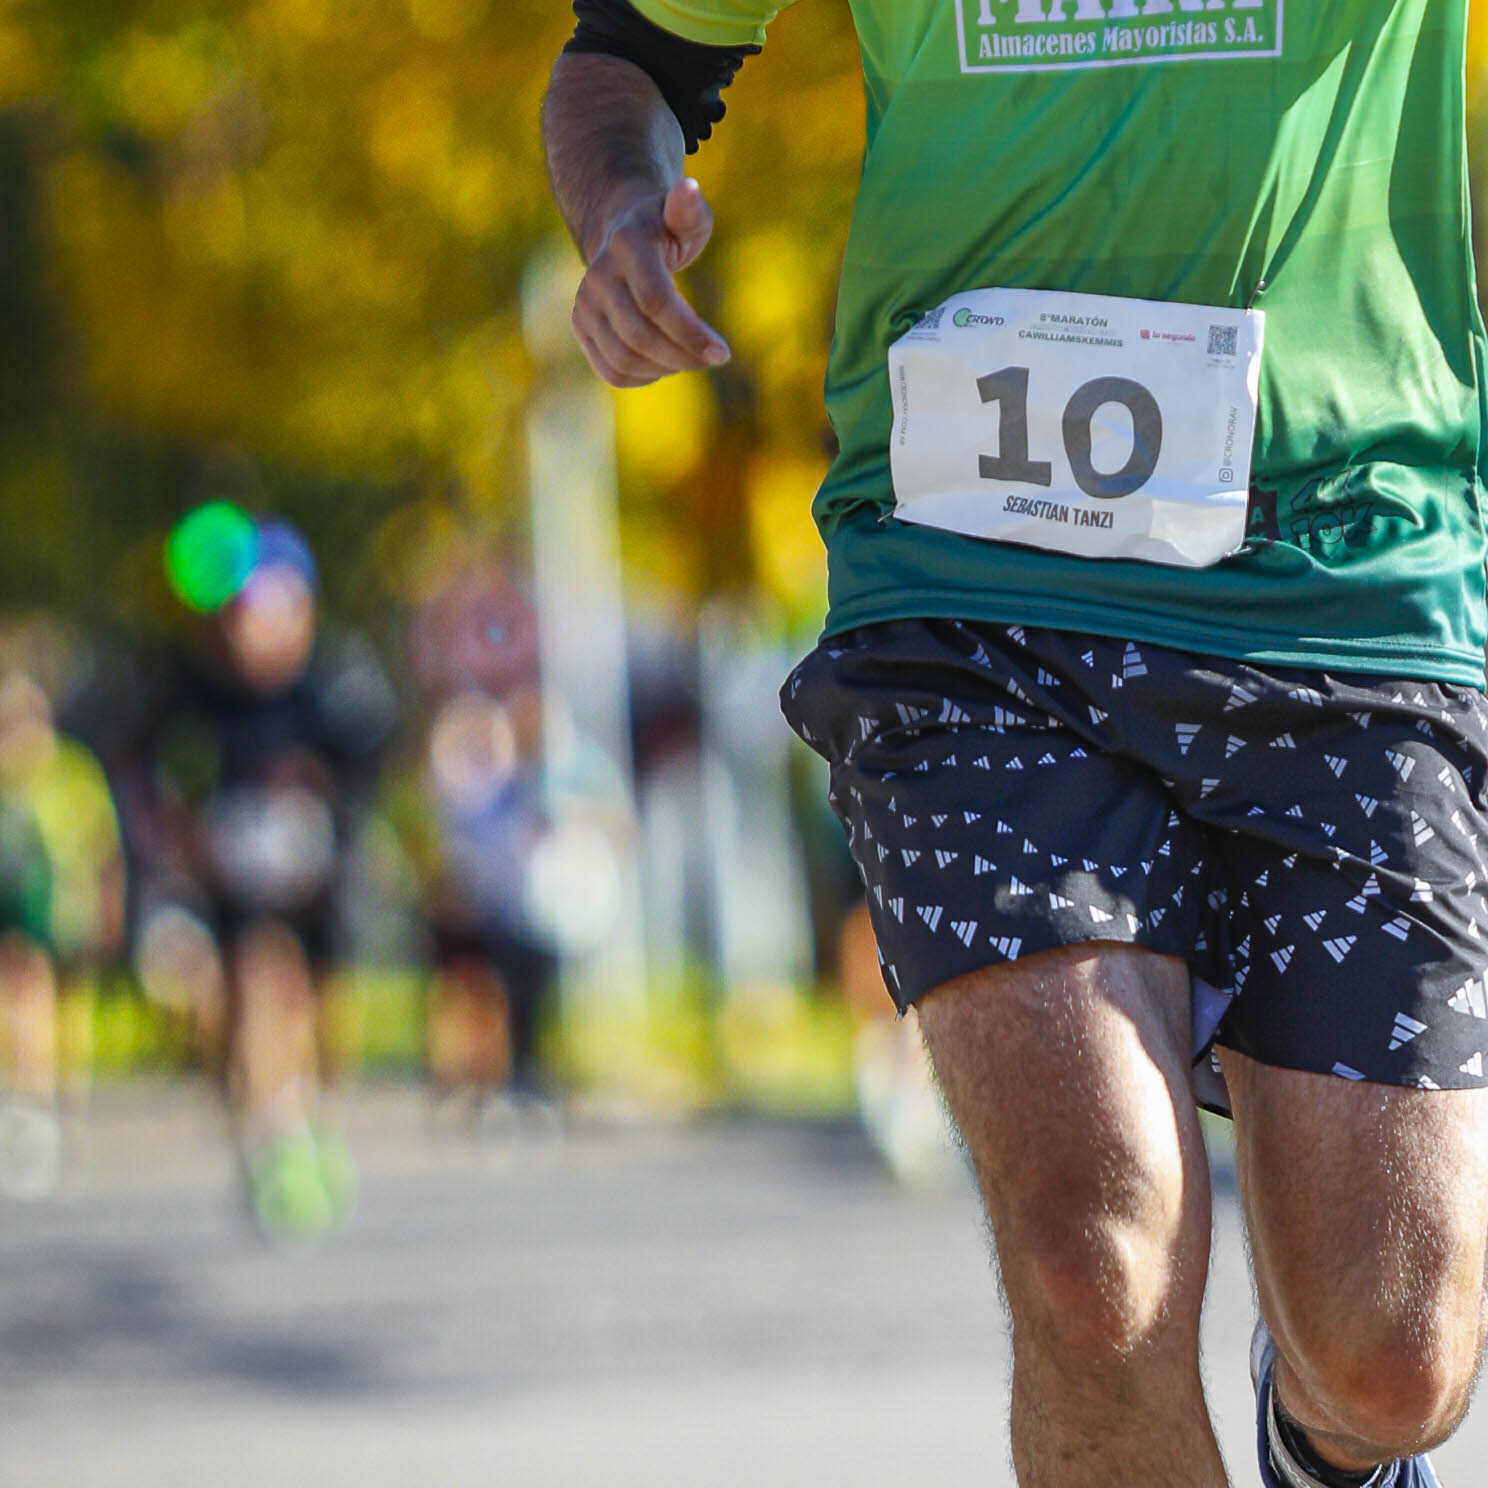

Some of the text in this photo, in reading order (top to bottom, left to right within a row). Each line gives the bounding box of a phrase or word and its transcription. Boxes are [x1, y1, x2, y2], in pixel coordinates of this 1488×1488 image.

[978, 16, 1264, 59] Almacenes Mayoristas S.A.
[1018, 330, 1123, 347] CAWILLIAMSKEMMIS
[976, 366, 1163, 500] 10
[1003, 495, 1115, 529] SEBASTIAN TANZI
